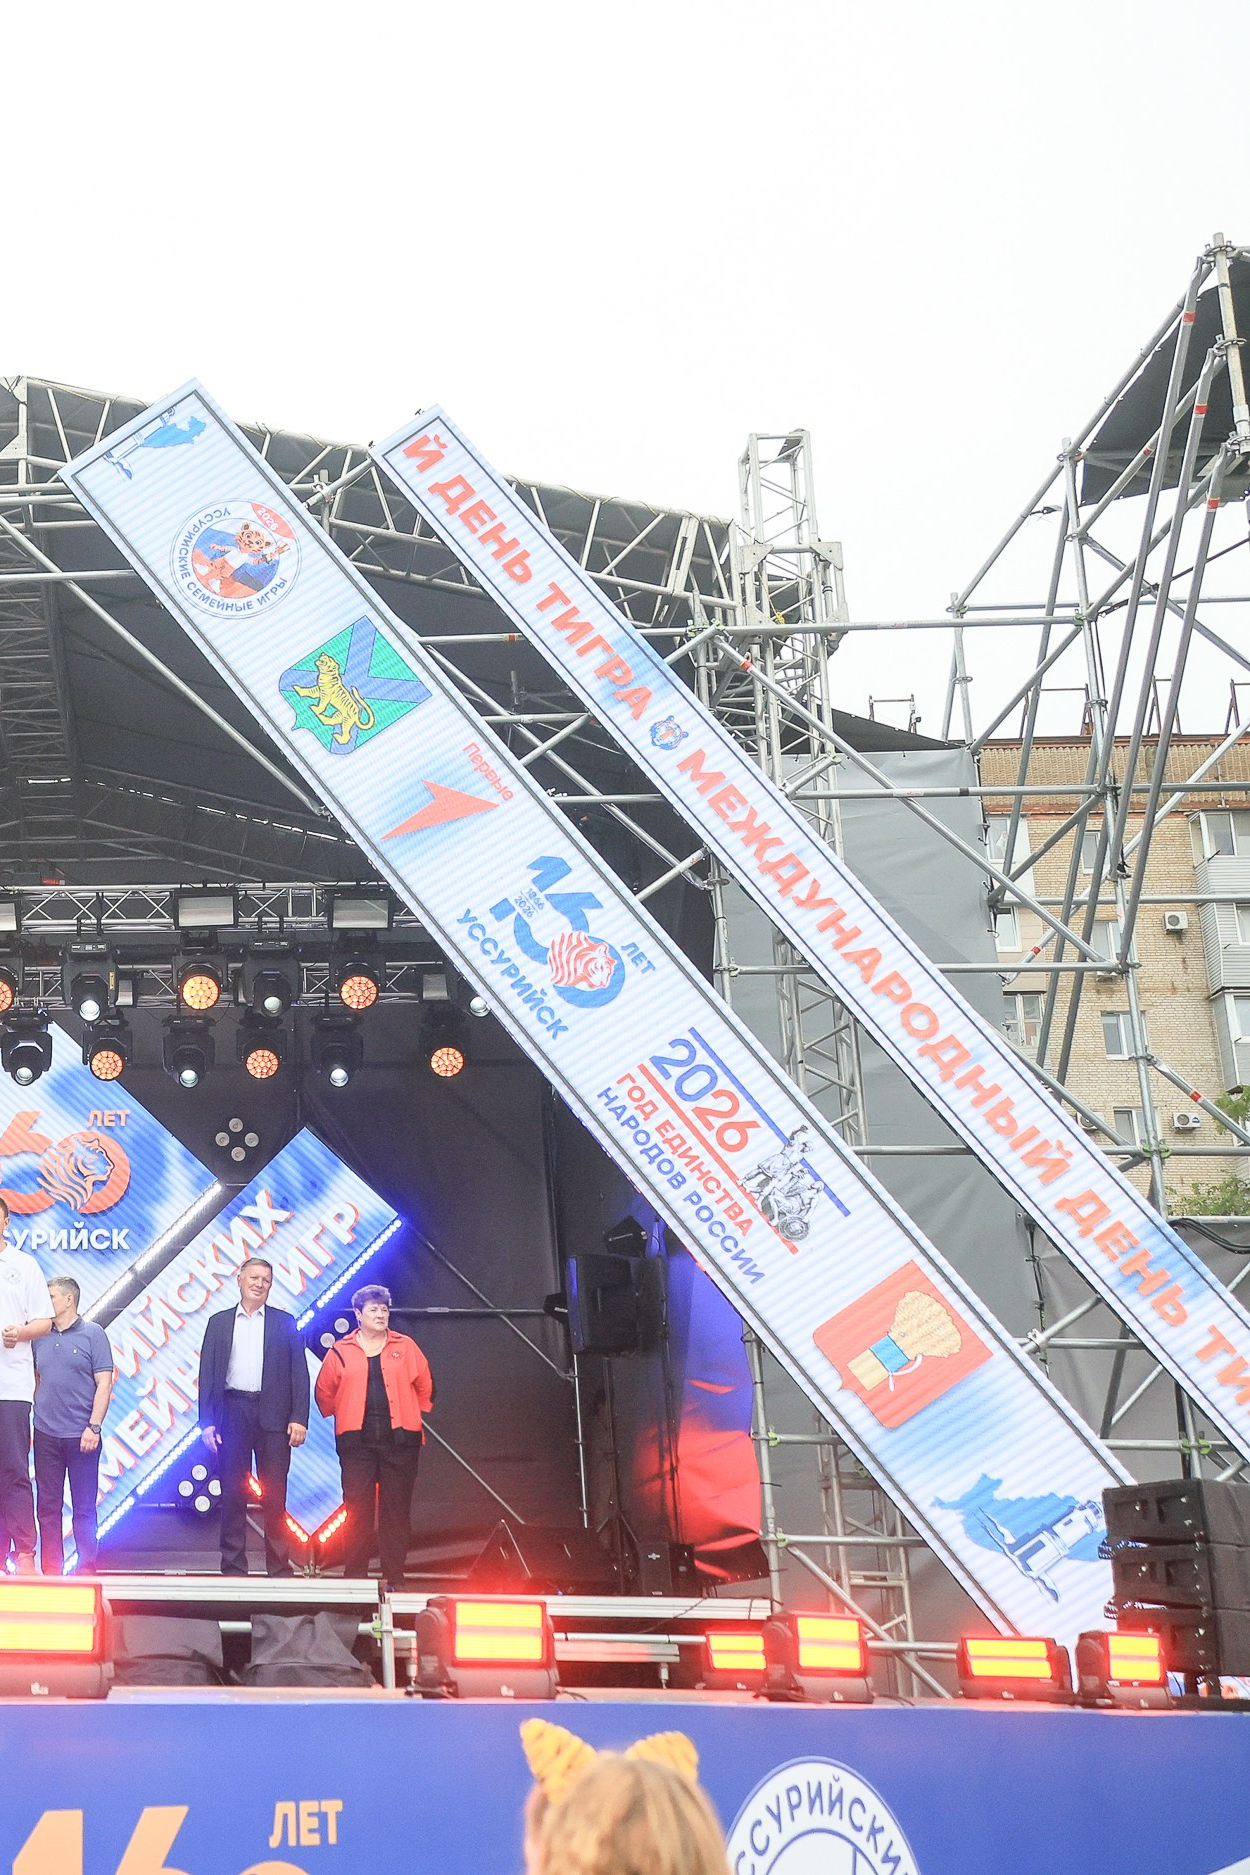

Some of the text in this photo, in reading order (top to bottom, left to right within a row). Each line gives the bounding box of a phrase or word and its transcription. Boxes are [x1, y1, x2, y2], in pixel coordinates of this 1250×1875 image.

[257, 508, 278, 531] 2026
[257, 577, 287, 606] ИГРЫ
[463, 742, 515, 801] Первые
[403, 434, 1250, 1406] Й ДЕНЬ ТИГРА МЕЖДУНАРОДНЫЙ ДЕНЬ ТИ
[514, 896, 533, 919] 2026
[526, 887, 545, 910] 1866
[457, 908, 568, 1040] УССУРИЙСК
[621, 942, 656, 975] ЛЕТ
[87, 1110, 131, 1128] ЛЕТ
[649, 1038, 761, 1153] 2026
[616, 1072, 754, 1237] ГОД ЕДИНСТВА
[597, 1086, 766, 1285] НАРОДОВ РОССИИ
[271, 1201, 361, 1298] ИГР
[268, 1799, 344, 1849] ЛЕТ
[734, 1775, 909, 1875] ССУРИЙСКИ
